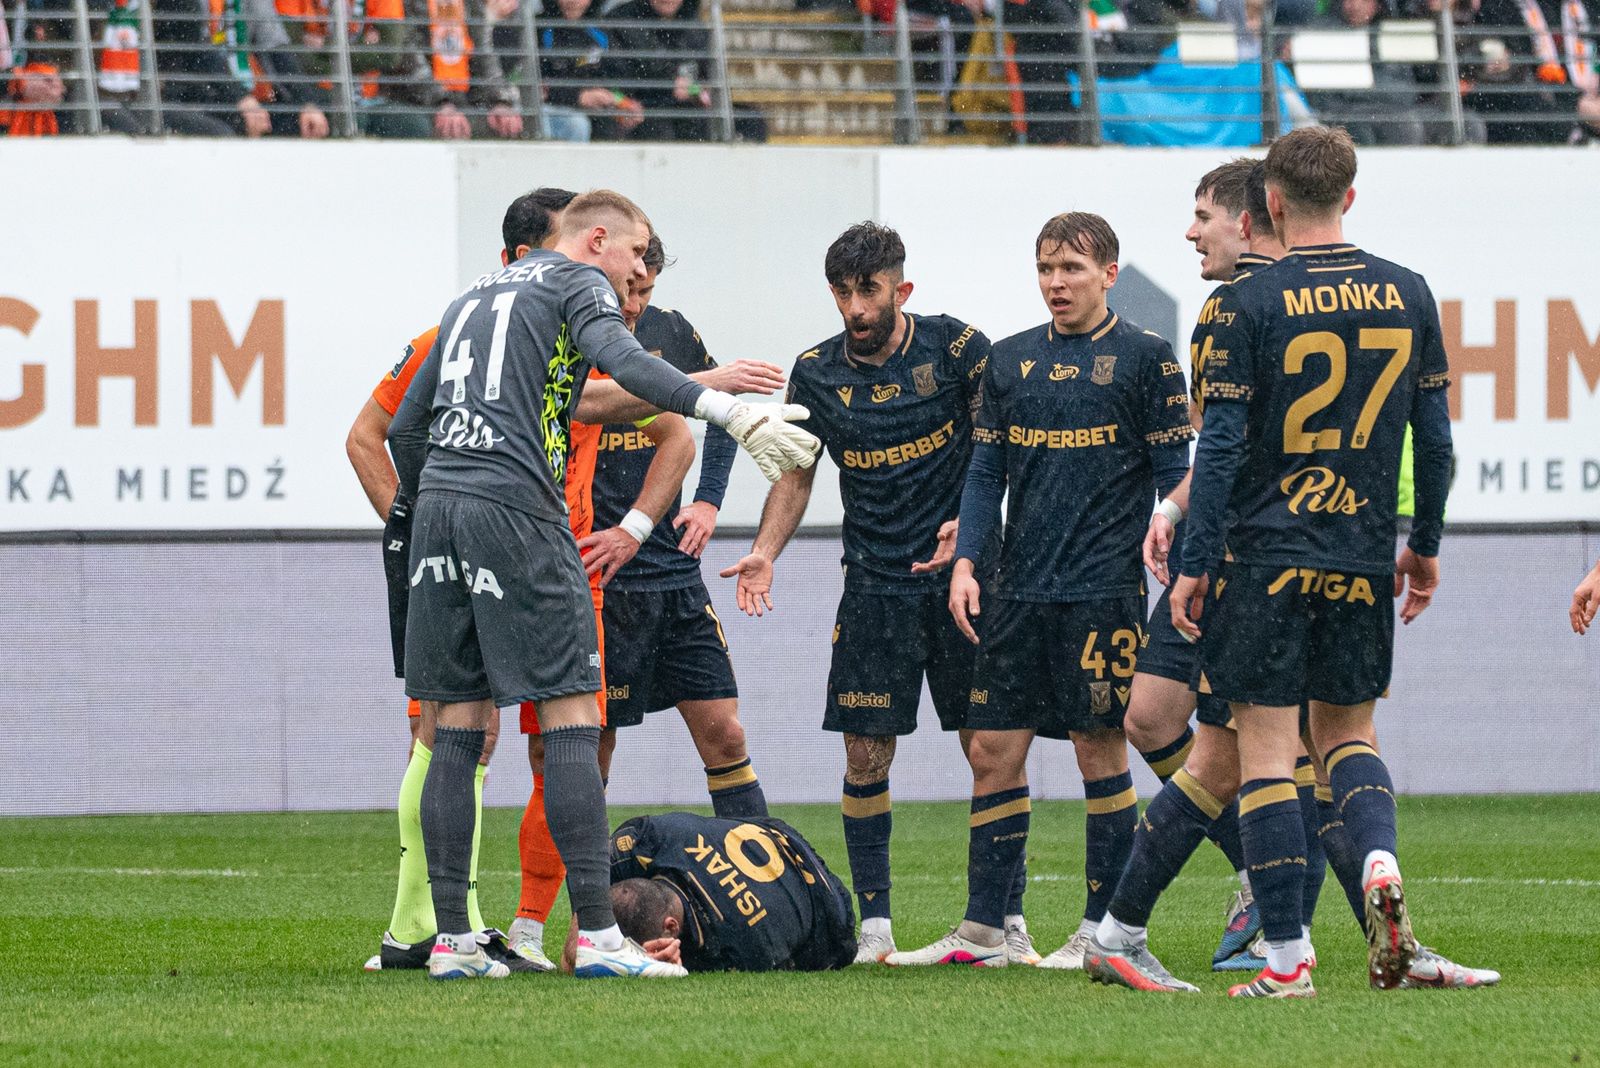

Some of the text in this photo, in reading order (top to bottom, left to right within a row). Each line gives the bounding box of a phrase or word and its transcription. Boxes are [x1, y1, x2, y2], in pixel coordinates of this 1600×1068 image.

[1283, 278, 1405, 317] MOŃKA
[440, 291, 518, 404] 41
[950, 325, 978, 358] Ebur
[1283, 327, 1413, 454] 27
[438, 408, 504, 448] Pils
[843, 420, 955, 469] SUPERBET
[1008, 424, 1119, 449] SUPERBET
[117, 457, 286, 500] MIEDŹ
[1280, 466, 1369, 515] Pils
[411, 555, 504, 600] STIGA
[1267, 567, 1376, 606] STIGA
[1080, 629, 1137, 679] 43
[684, 833, 768, 927] ISHAK
